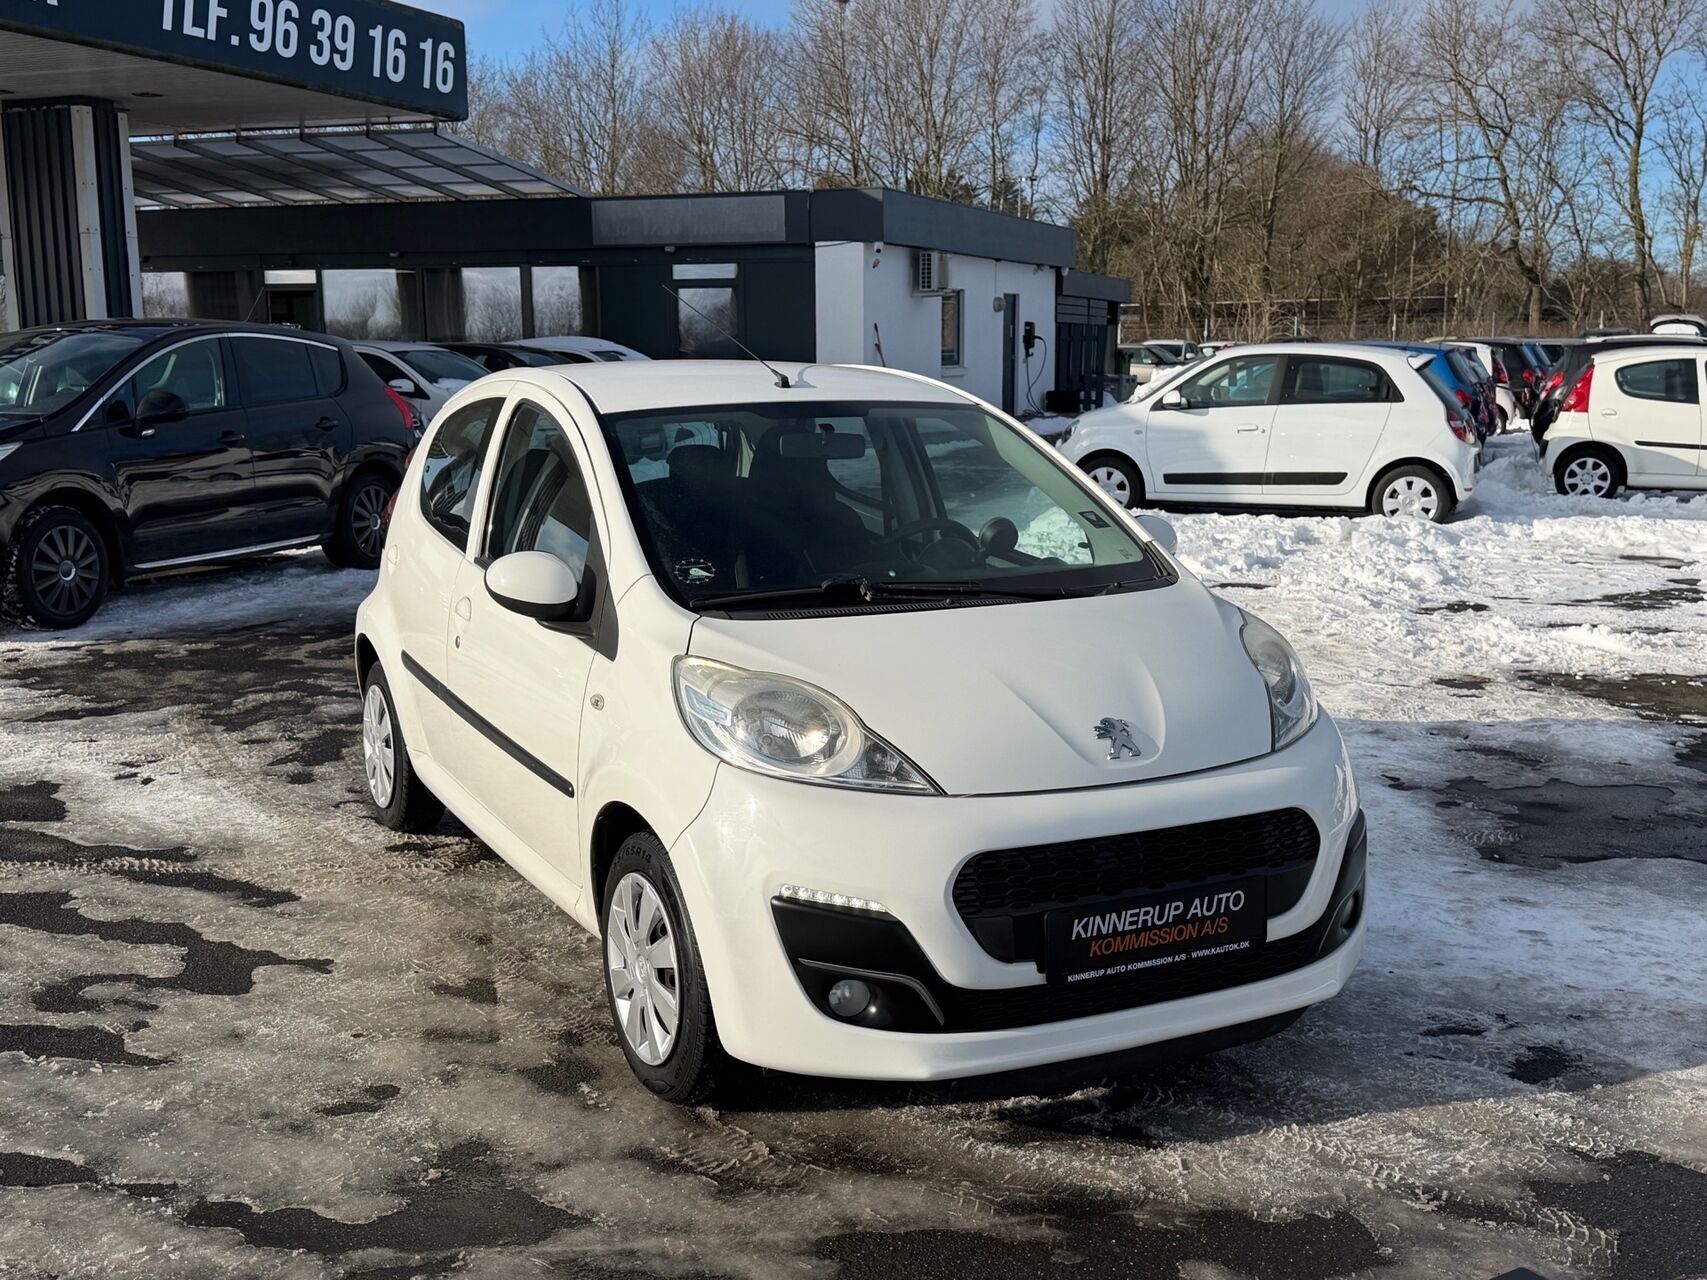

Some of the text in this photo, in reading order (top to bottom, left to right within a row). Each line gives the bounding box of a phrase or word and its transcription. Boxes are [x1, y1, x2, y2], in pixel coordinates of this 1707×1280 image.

[249, 0, 299, 58] 96
[310, 9, 355, 71] 39
[369, 25, 407, 83] 16
[420, 38, 455, 94] 16
[1072, 890, 1245, 940] KINNERUP AUTO
[1090, 917, 1229, 957] KOMMISSION A/S
[1068, 969, 1105, 982] KINNERUP
[1106, 965, 1126, 975] AUTO
[1127, 956, 1173, 971] KOMMISSION
[1174, 953, 1187, 962] A/S
[1191, 940, 1250, 958] WWW.KAUTOK.DK
